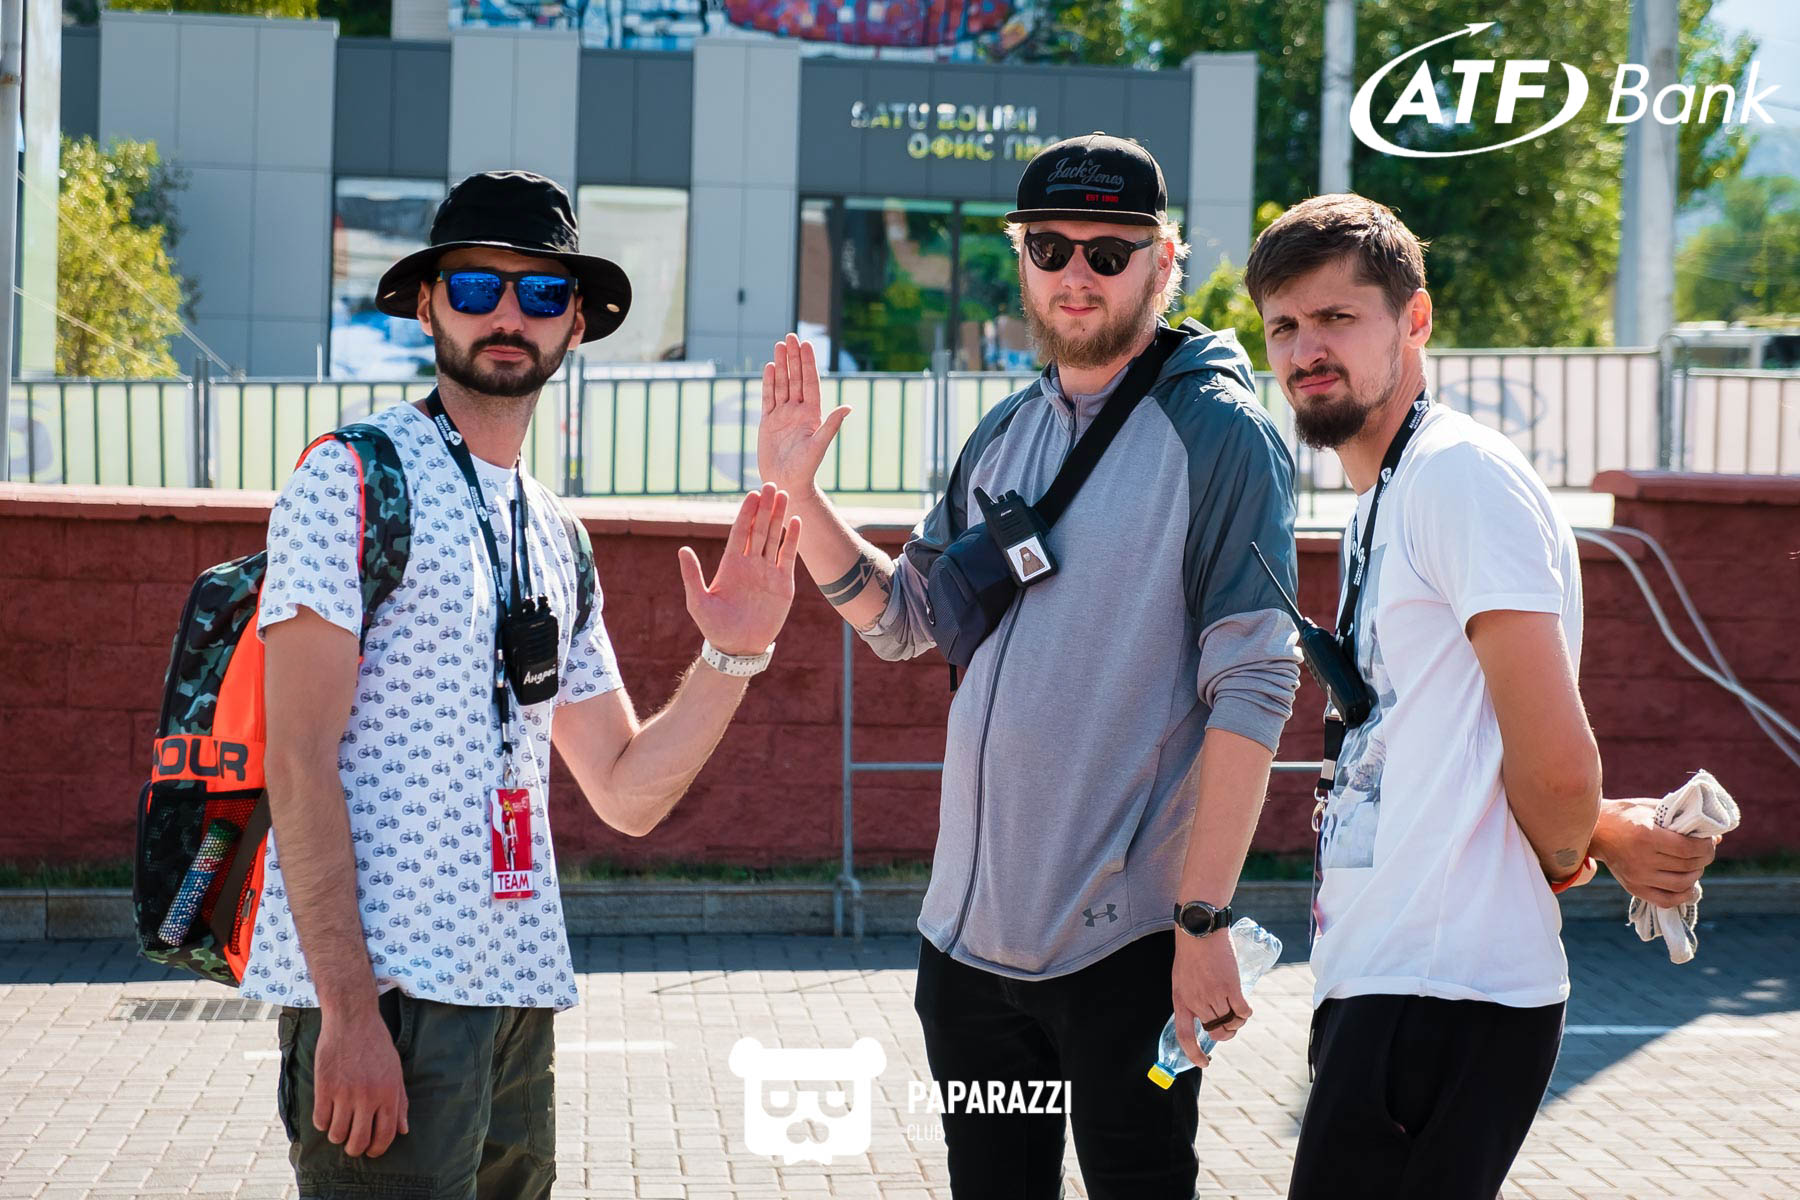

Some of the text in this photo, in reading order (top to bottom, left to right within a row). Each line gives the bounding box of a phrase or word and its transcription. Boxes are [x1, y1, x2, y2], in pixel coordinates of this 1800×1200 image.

[907, 132, 994, 161] ОФИС
[1047, 157, 1088, 183] Jack
[497, 873, 530, 891] TEAM
